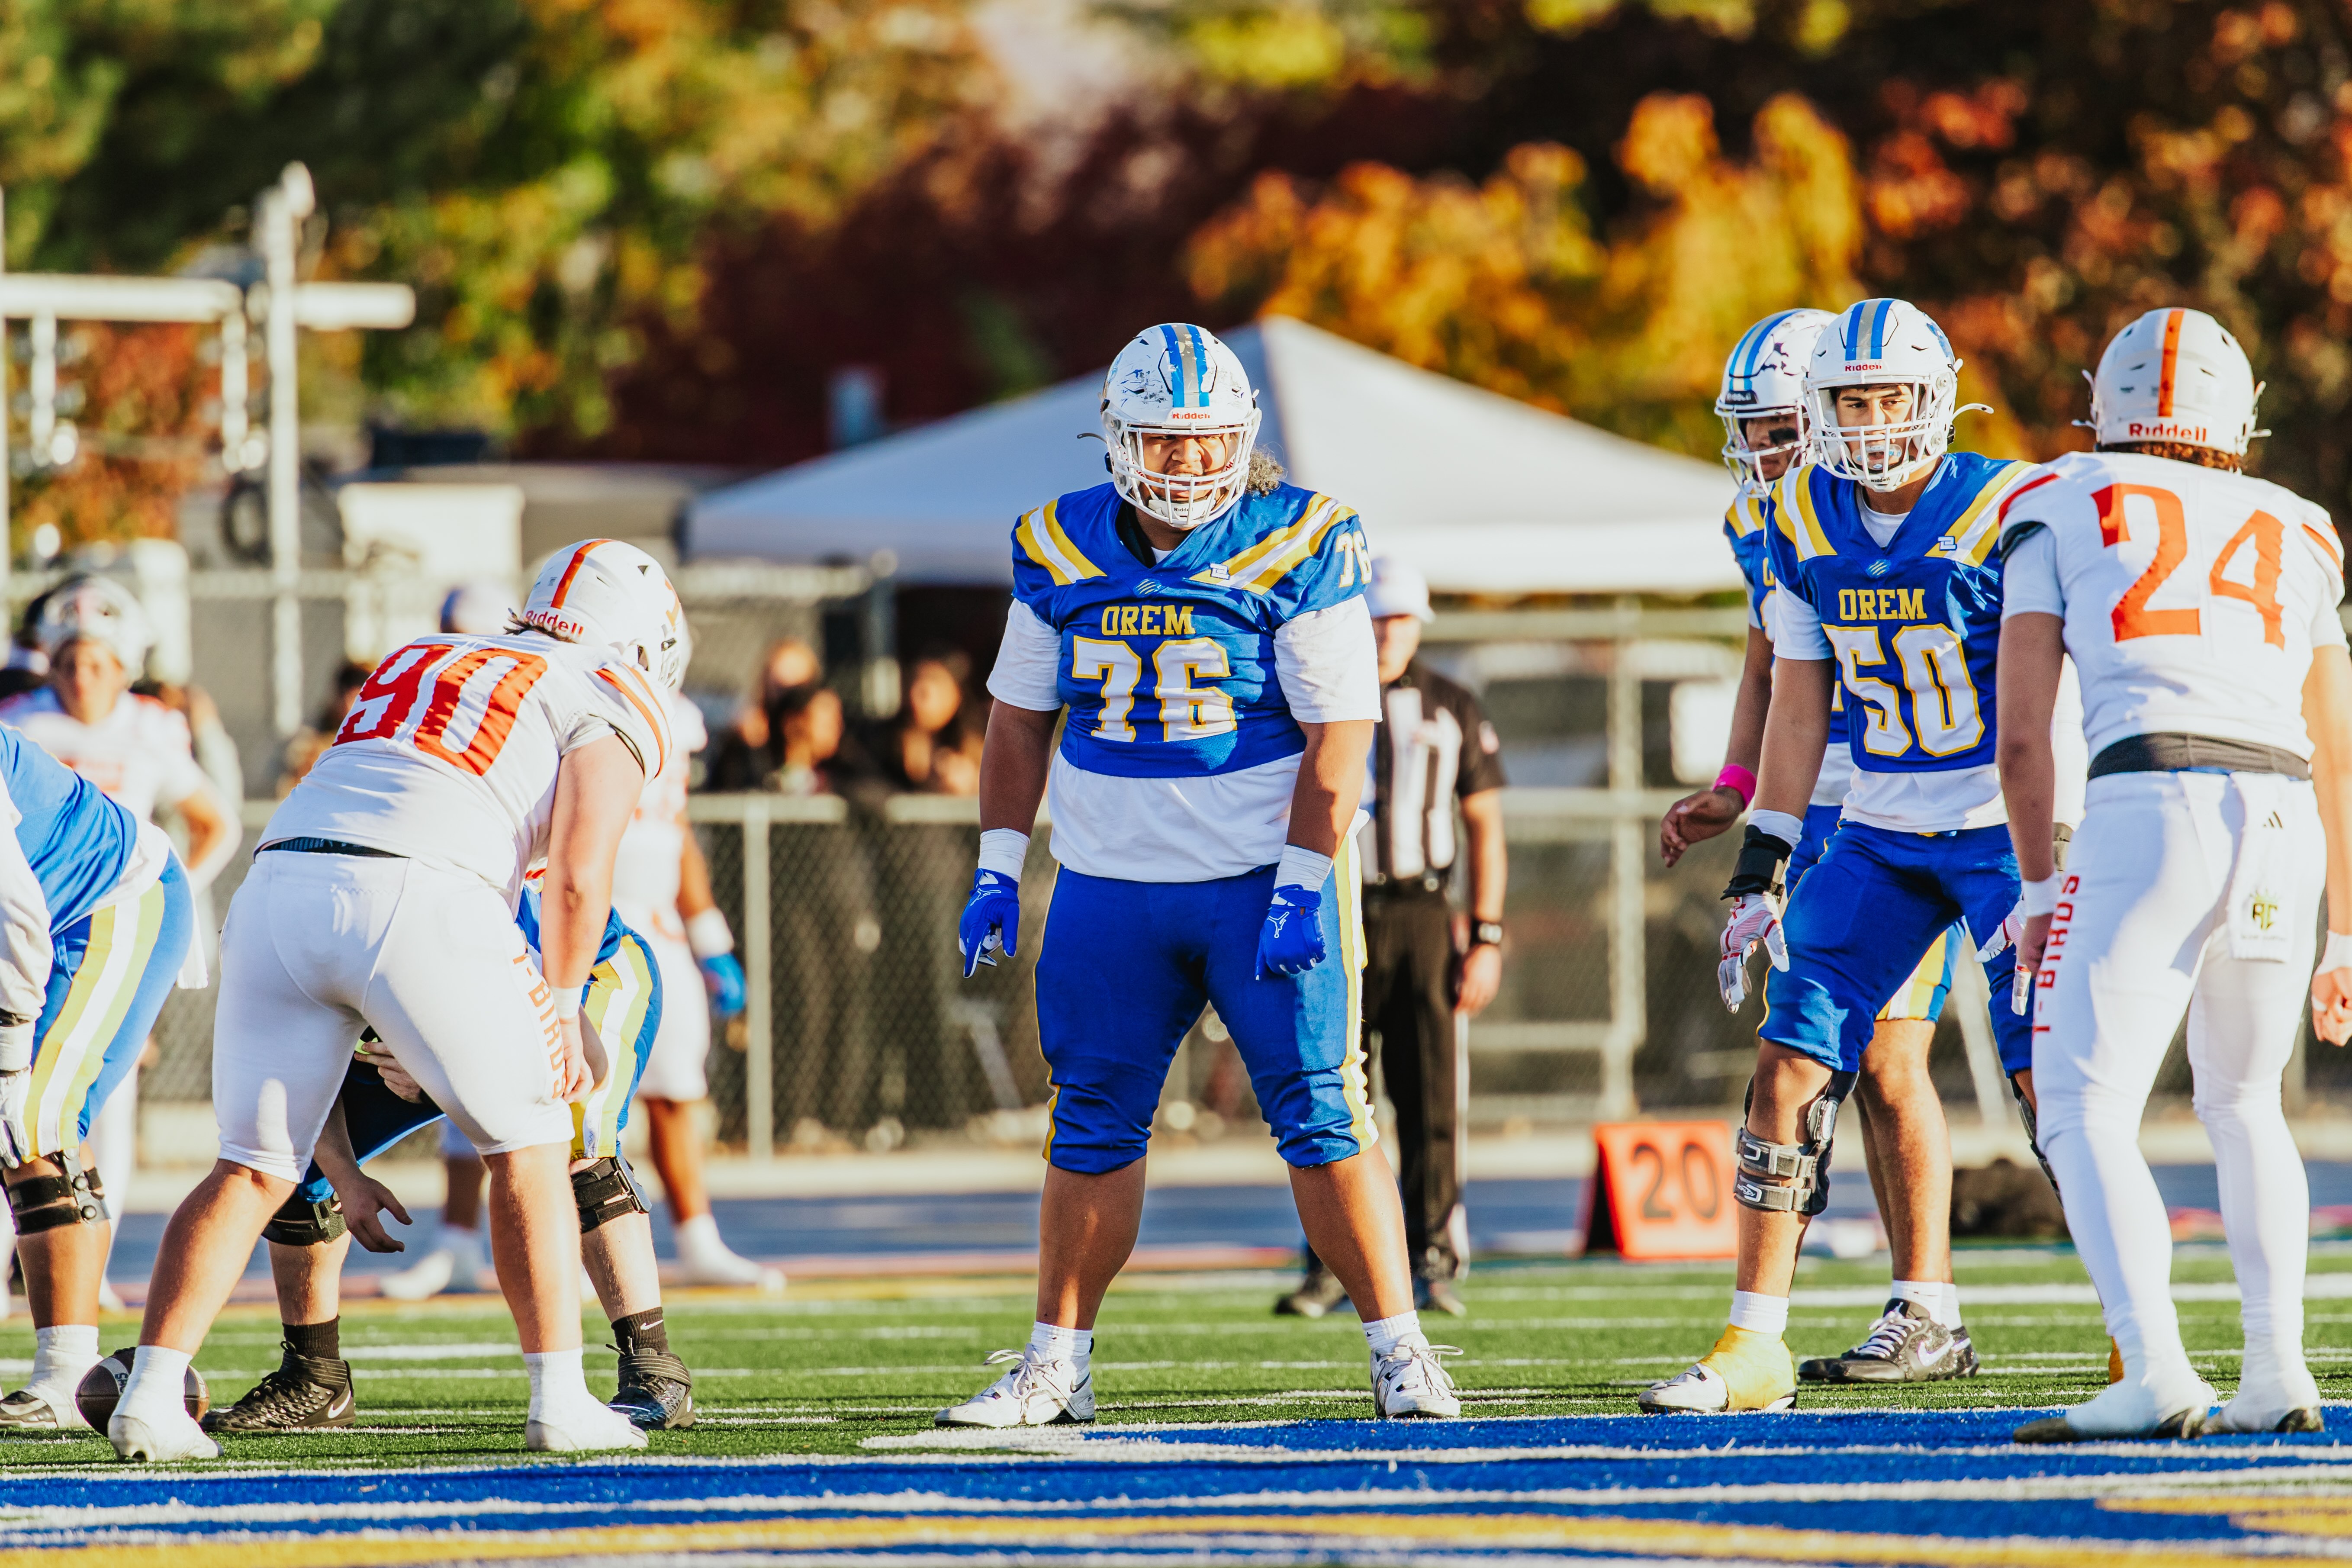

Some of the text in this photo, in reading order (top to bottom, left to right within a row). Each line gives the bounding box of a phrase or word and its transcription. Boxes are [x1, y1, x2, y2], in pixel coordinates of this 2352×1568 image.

[1845, 363, 1882, 372] Riddell
[2129, 422, 2207, 442] Riddell
[1335, 530, 1372, 588] 76
[2090, 483, 2286, 651] 24
[525, 610, 584, 638] Riddell
[1101, 605, 1195, 636] OREM
[1838, 589, 1927, 620] OREM
[332, 644, 548, 776] 90
[1071, 635, 1238, 743] 76
[1821, 623, 1985, 757] 50
[1630, 1142, 1721, 1220] 20
